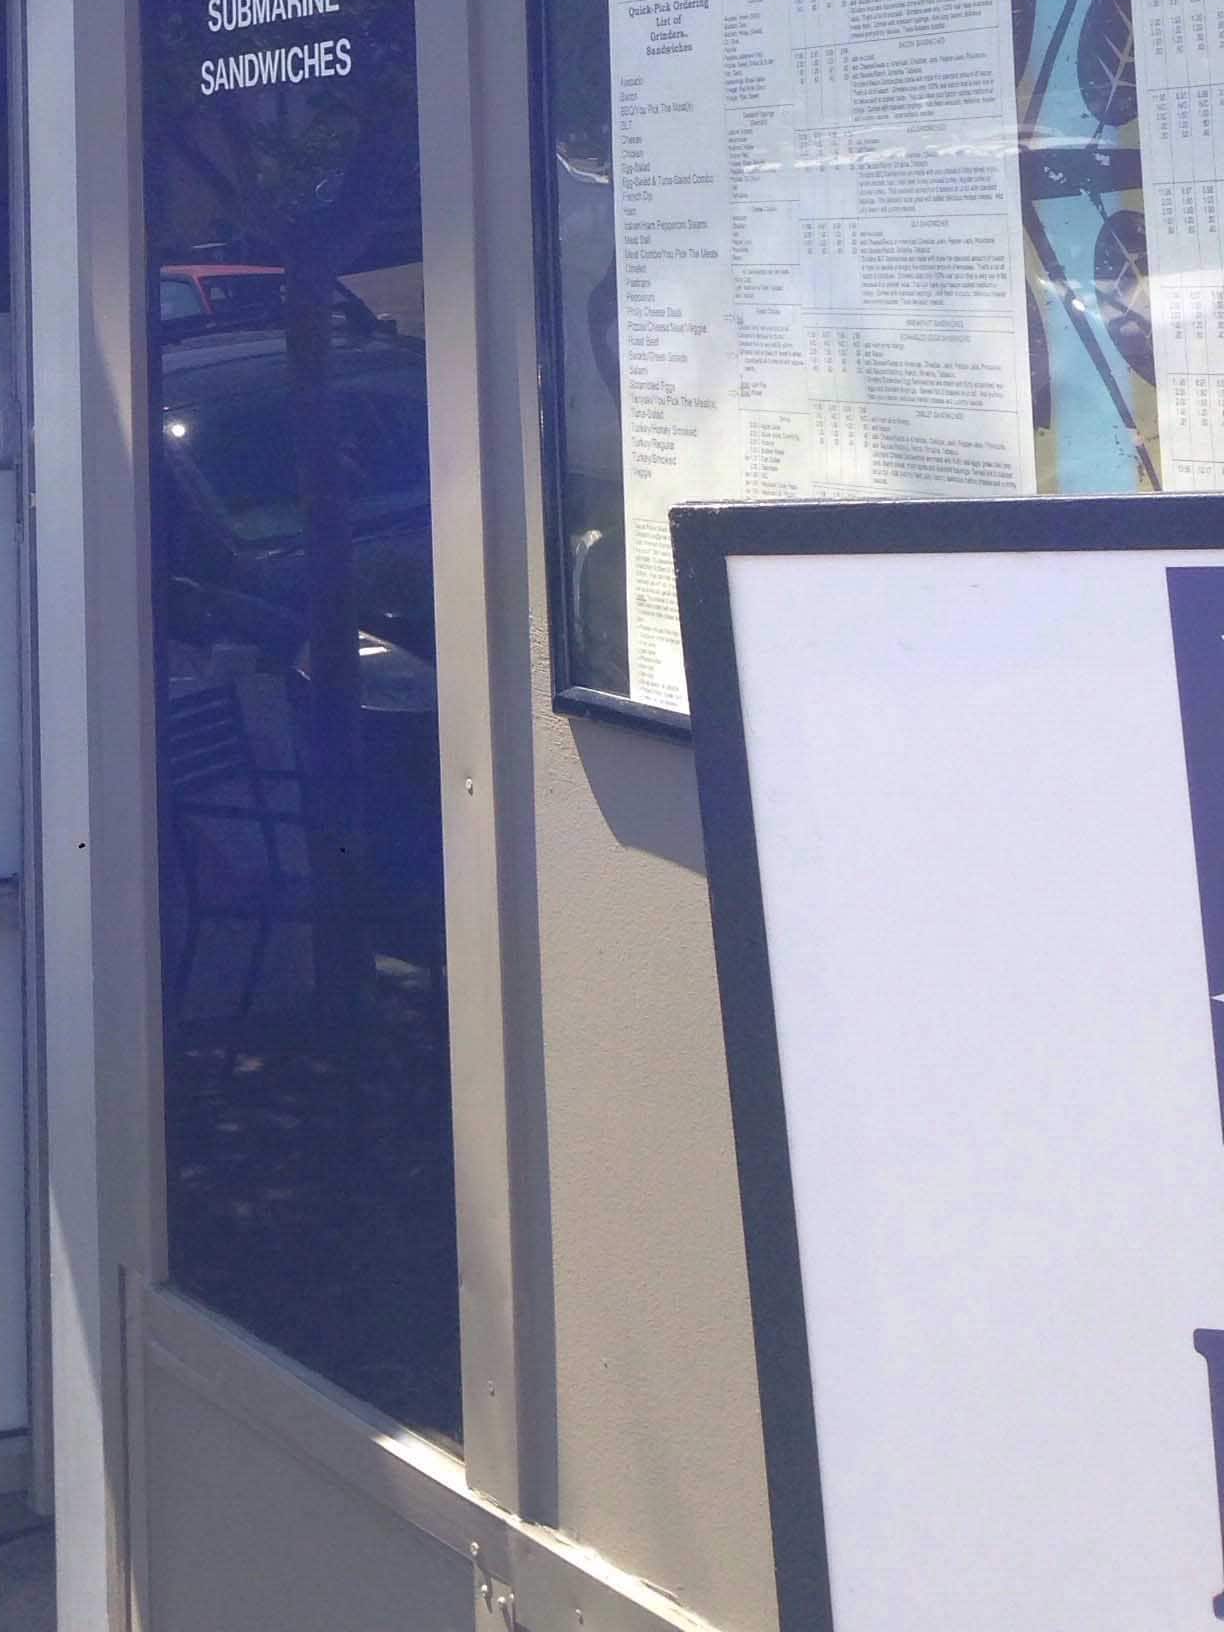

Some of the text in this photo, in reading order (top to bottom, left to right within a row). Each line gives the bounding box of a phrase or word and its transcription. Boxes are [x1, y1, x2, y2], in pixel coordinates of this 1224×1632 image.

[656, 14, 682, 27] List of
[200, 37, 352, 96] SANDWICHES
